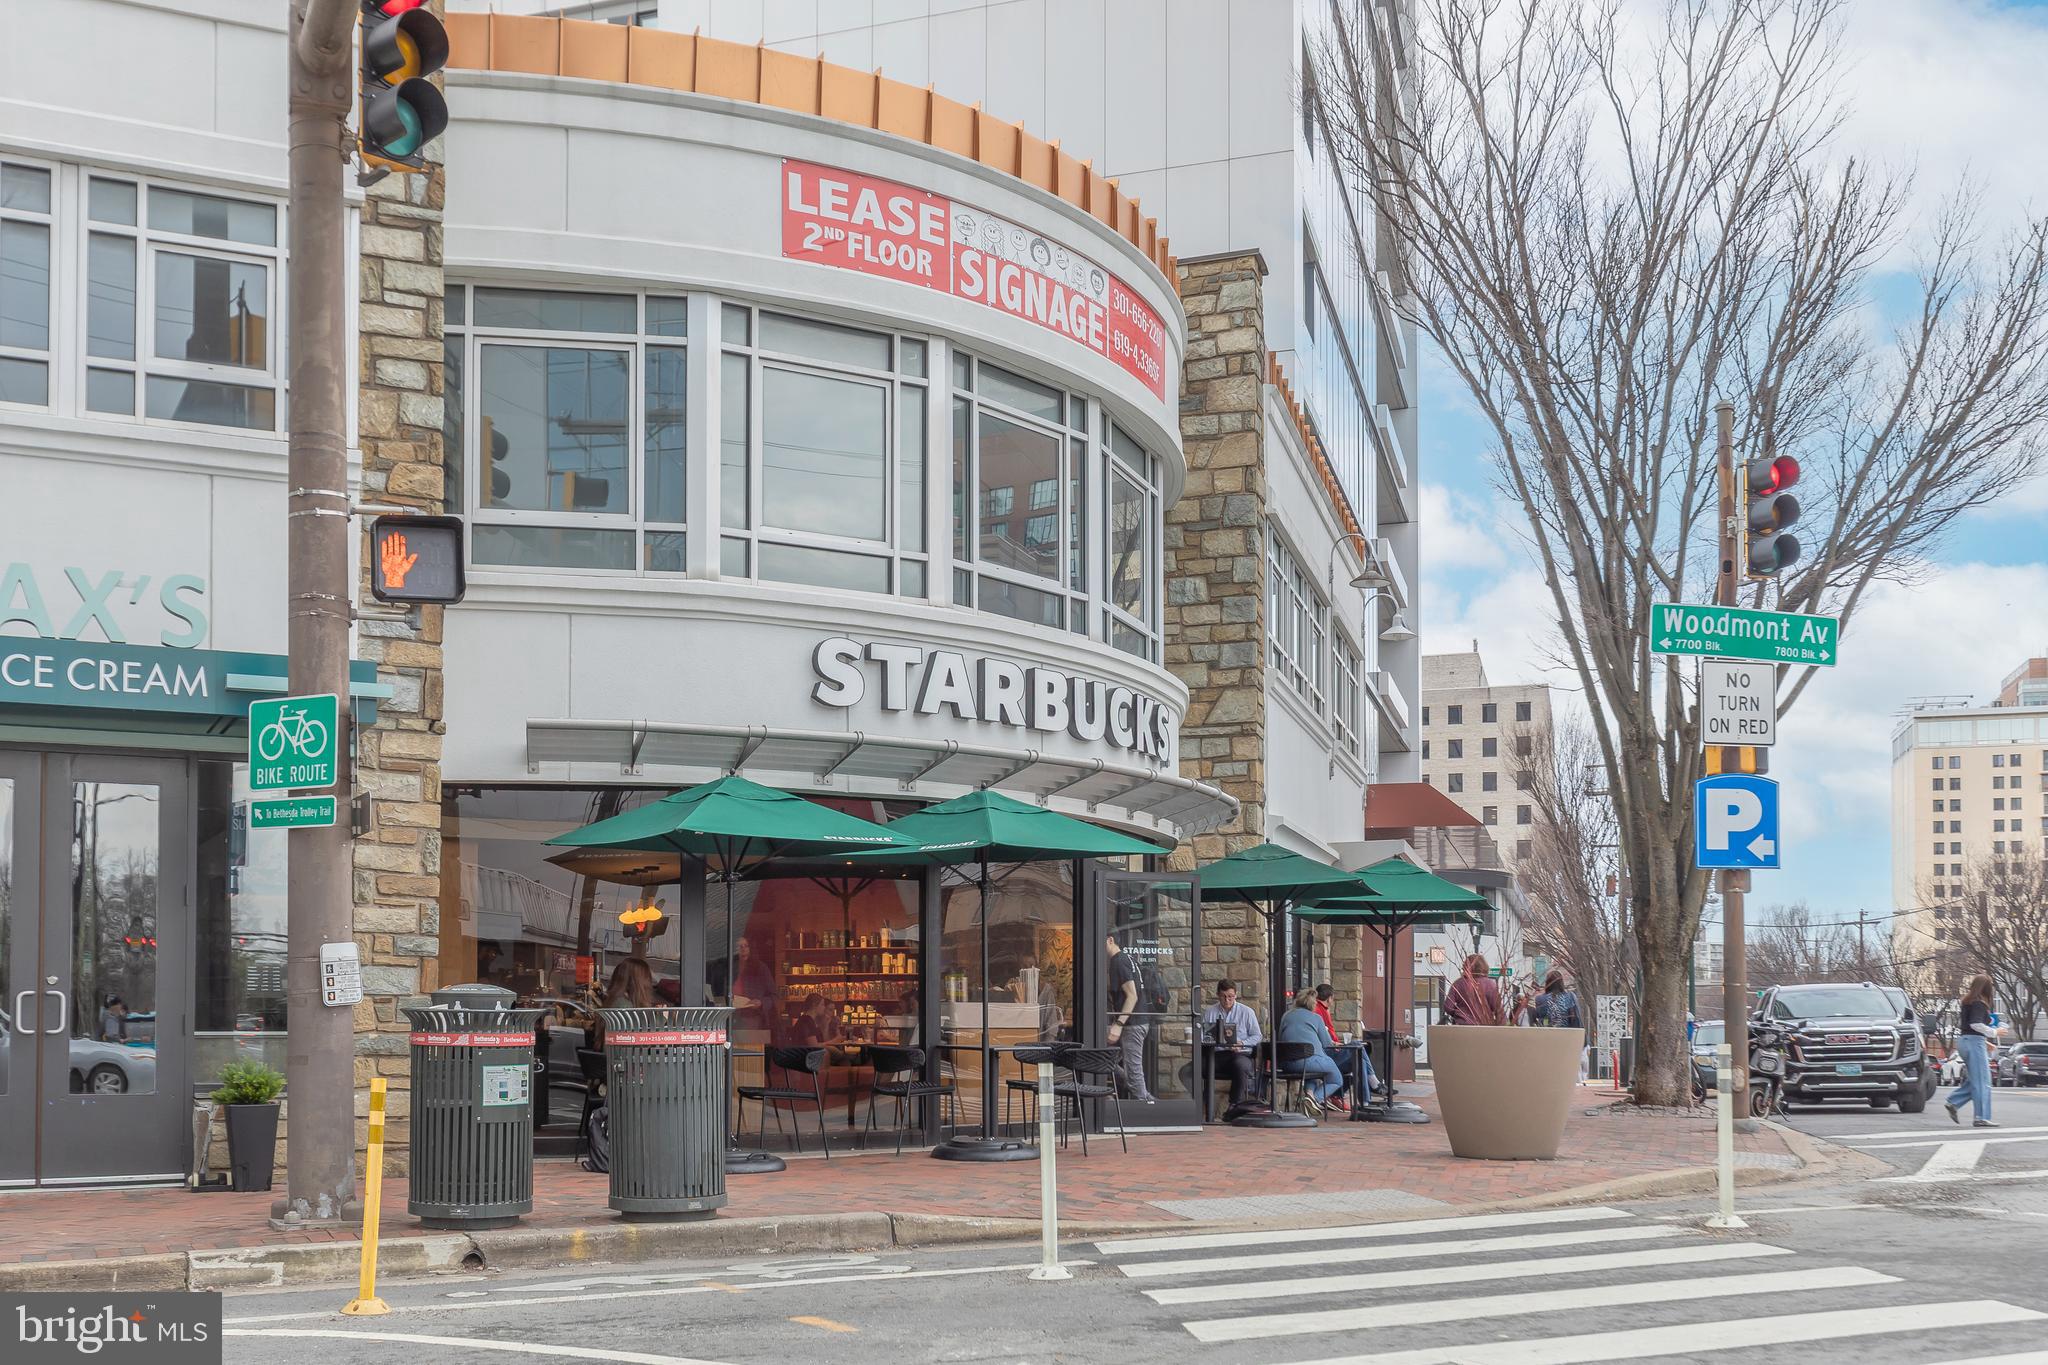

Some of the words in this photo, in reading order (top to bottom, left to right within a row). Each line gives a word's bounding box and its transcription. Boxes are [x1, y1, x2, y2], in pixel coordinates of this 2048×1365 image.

[788, 172, 946, 246] LEASE
[802, 222, 845, 252] 2ND
[847, 232, 932, 277] FLOOR
[959, 249, 1105, 351] SIGNAGE
[1664, 608, 1790, 641] Woodmont
[1800, 619, 1828, 645] Av
[1674, 638, 1702, 650] 7700
[1775, 646, 1799, 658] 7800
[67, 658, 208, 697] CREAM
[1726, 672, 1751, 688] NO
[811, 637, 1171, 760] STARBUCKS
[1718, 695, 1760, 712] TURN
[1710, 718, 1730, 733] ON
[1739, 719, 1769, 735] RED
[256, 766, 284, 785] BIKE
[290, 764, 328, 782] ROUTE
[265, 808, 272, 819] To
[273, 808, 298, 819] Bethesda
[300, 806, 318, 818] Trolley
[319, 806, 331, 816] Trail
[1705, 788, 1763, 850] P
[1122, 946, 1174, 955] STARBUCKS
